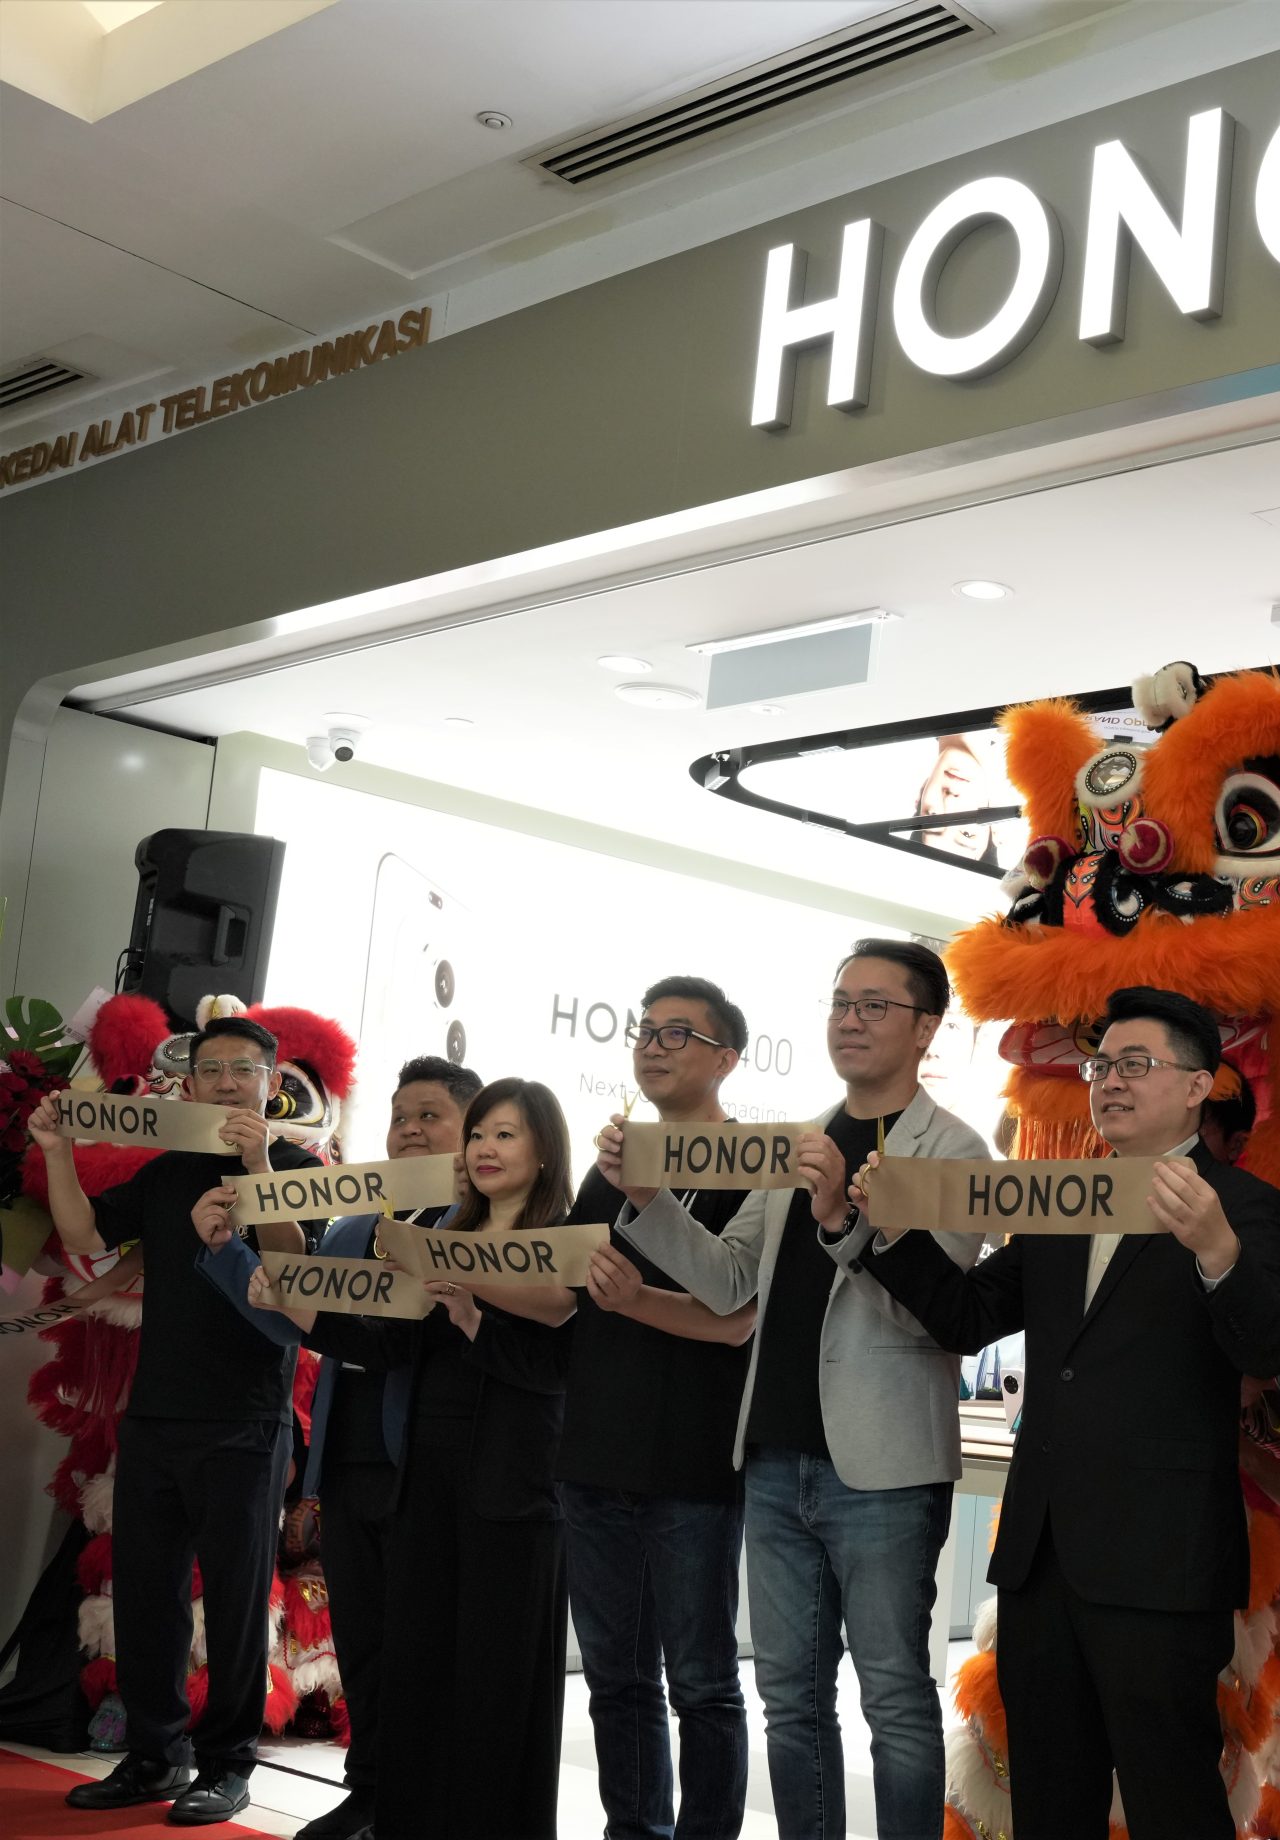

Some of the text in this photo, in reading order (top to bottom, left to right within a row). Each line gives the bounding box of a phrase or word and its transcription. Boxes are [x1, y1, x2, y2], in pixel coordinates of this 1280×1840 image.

[0, 306, 432, 489] KEDAI ALAT TELEKOMUNIKASI
[58, 1098, 158, 1137] HONOR
[664, 1134, 791, 1175] HONOR
[255, 1171, 388, 1212] HONOR
[968, 1174, 1114, 1217] HONOR
[425, 1238, 558, 1273] HONOR
[278, 1263, 394, 1304] HONOR
